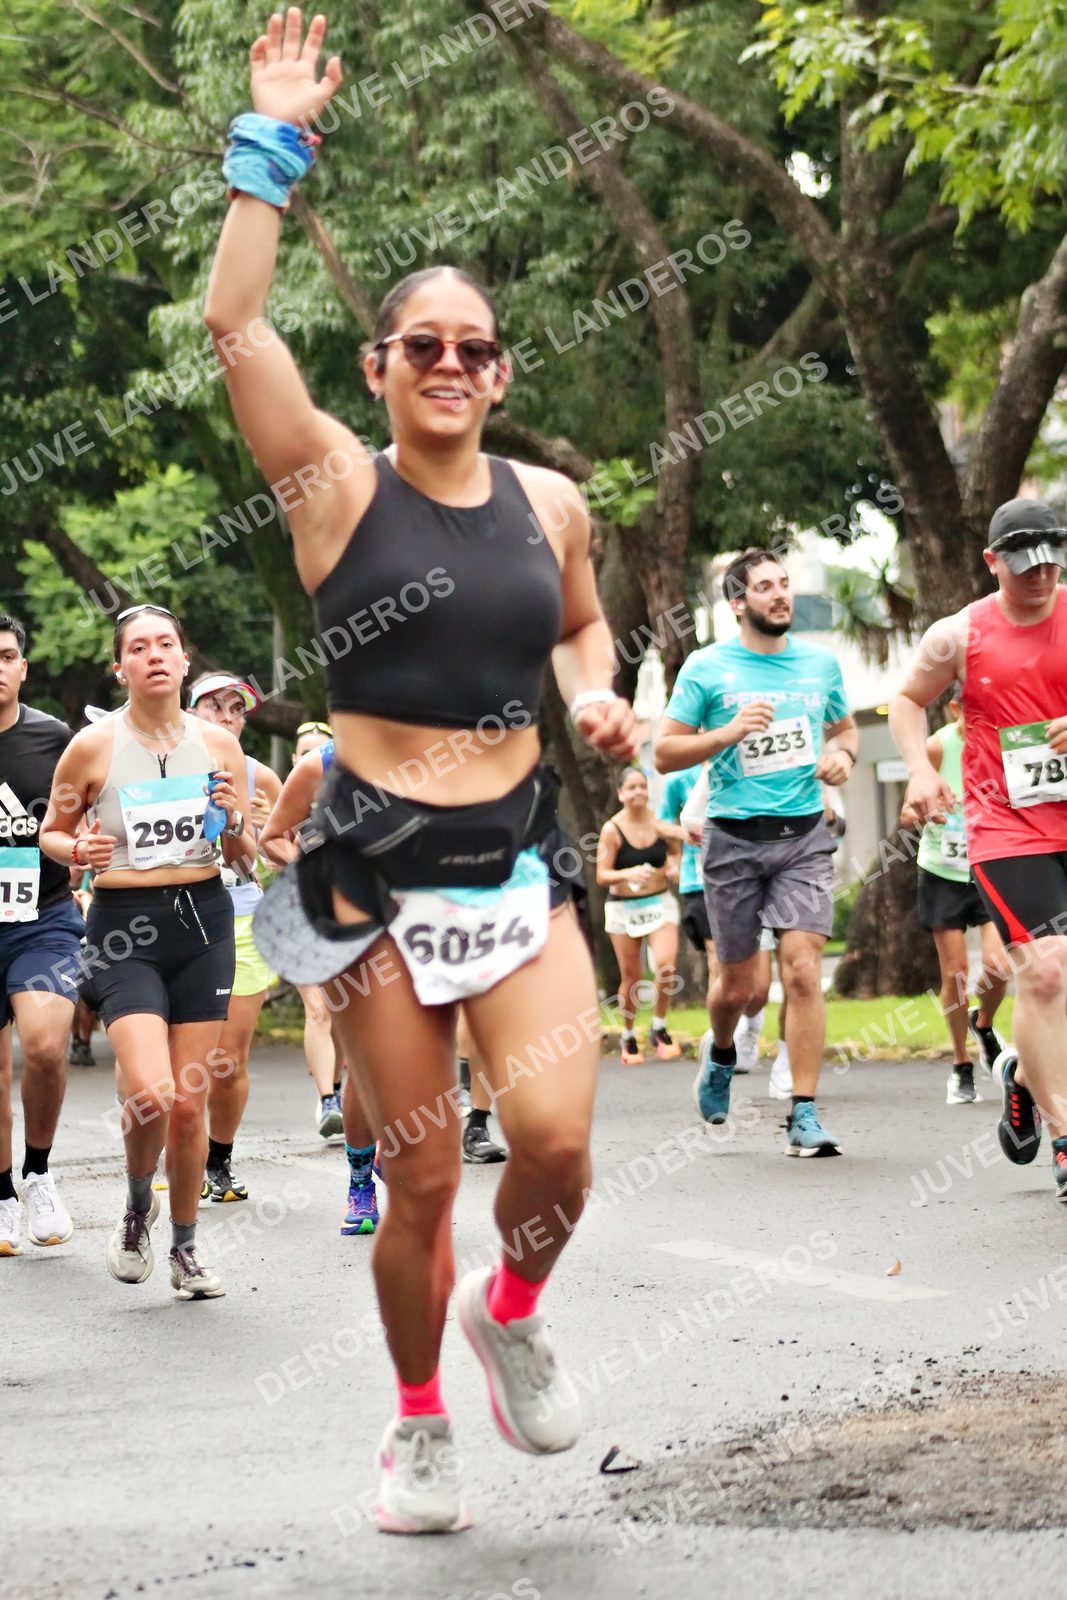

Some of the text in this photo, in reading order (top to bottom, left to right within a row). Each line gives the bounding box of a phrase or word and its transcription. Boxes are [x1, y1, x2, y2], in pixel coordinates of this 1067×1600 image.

[743, 730, 806, 759] 3233
[1023, 756, 1067, 787] 78
[403, 916, 534, 965] 6054
